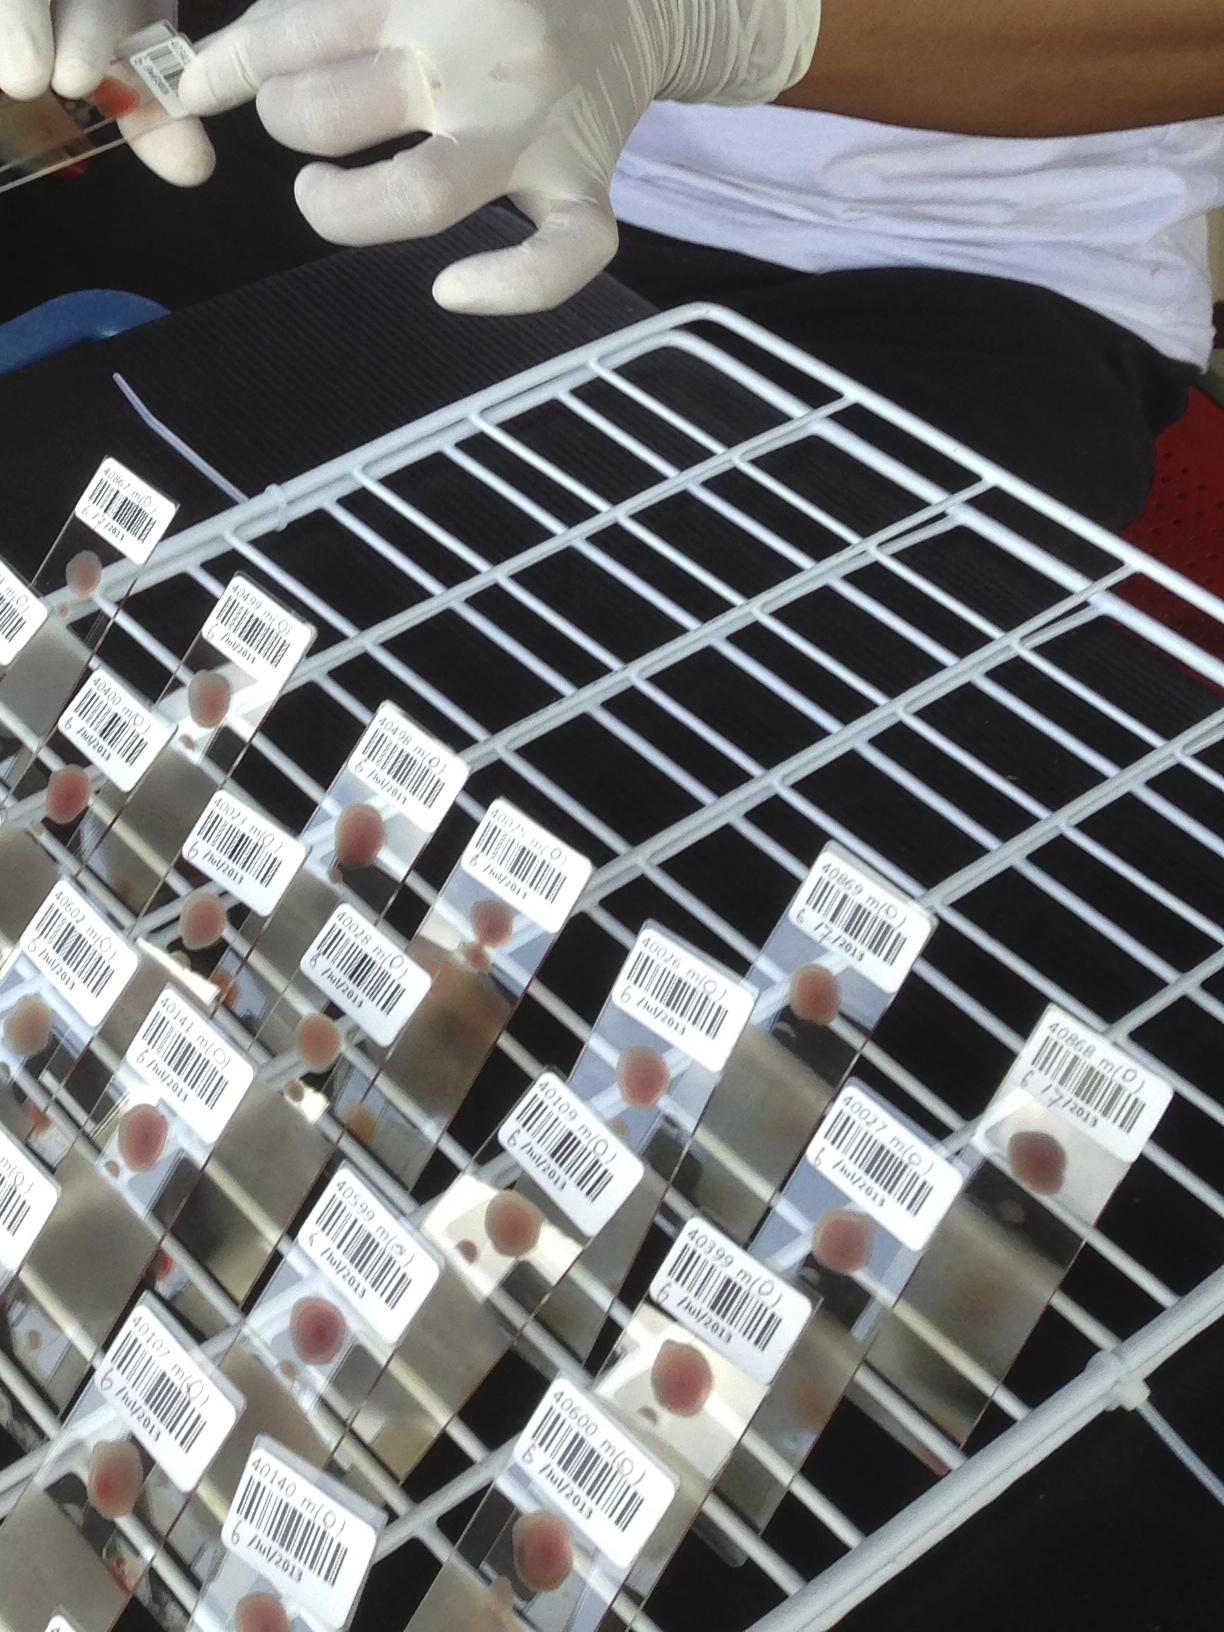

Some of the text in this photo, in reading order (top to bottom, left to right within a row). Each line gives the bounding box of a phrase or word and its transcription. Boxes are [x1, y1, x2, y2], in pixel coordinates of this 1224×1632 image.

[91, 678, 122, 706] 40400
[379, 717, 412, 746] 40498
[821, 863, 864, 896] 40869
[55, 891, 85, 924] 40602
[336, 912, 372, 946] 40028
[642, 937, 682, 969] 40026
[161, 998, 194, 1033] 40141
[1048, 1022, 1096, 1059] 40868
[538, 1081, 578, 1121] 40109
[842, 1096, 888, 1132] 40027
[336, 1180, 375, 1222] 40599
[687, 1228, 734, 1268] 40399
[133, 1316, 170, 1356] 40107
[553, 1391, 598, 1436] 40600
[252, 1458, 296, 1497] 40140
